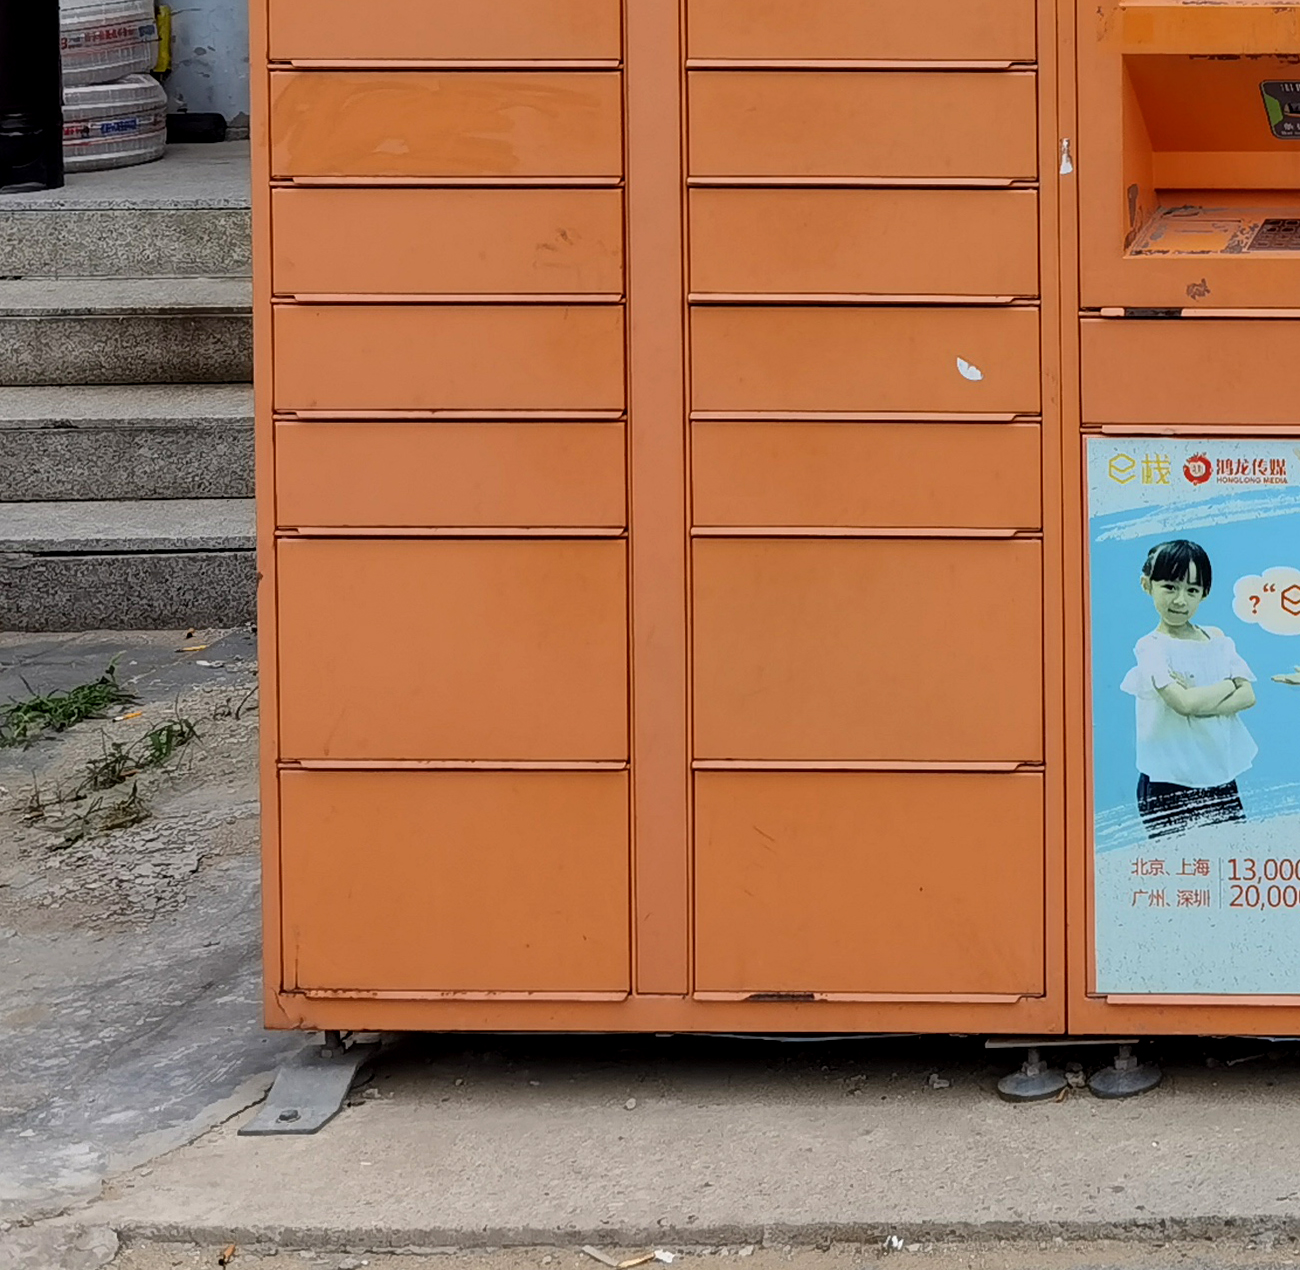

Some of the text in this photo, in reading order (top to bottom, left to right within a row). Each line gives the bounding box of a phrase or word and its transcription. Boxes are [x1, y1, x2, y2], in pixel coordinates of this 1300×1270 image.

[1215, 457, 1288, 477] 鸿龙传媒
[1215, 476, 1289, 485] HONGLONG MEDIA
[1131, 858, 1210, 877] 北京、上海
[1131, 889, 1211, 908] 广州、深圳
